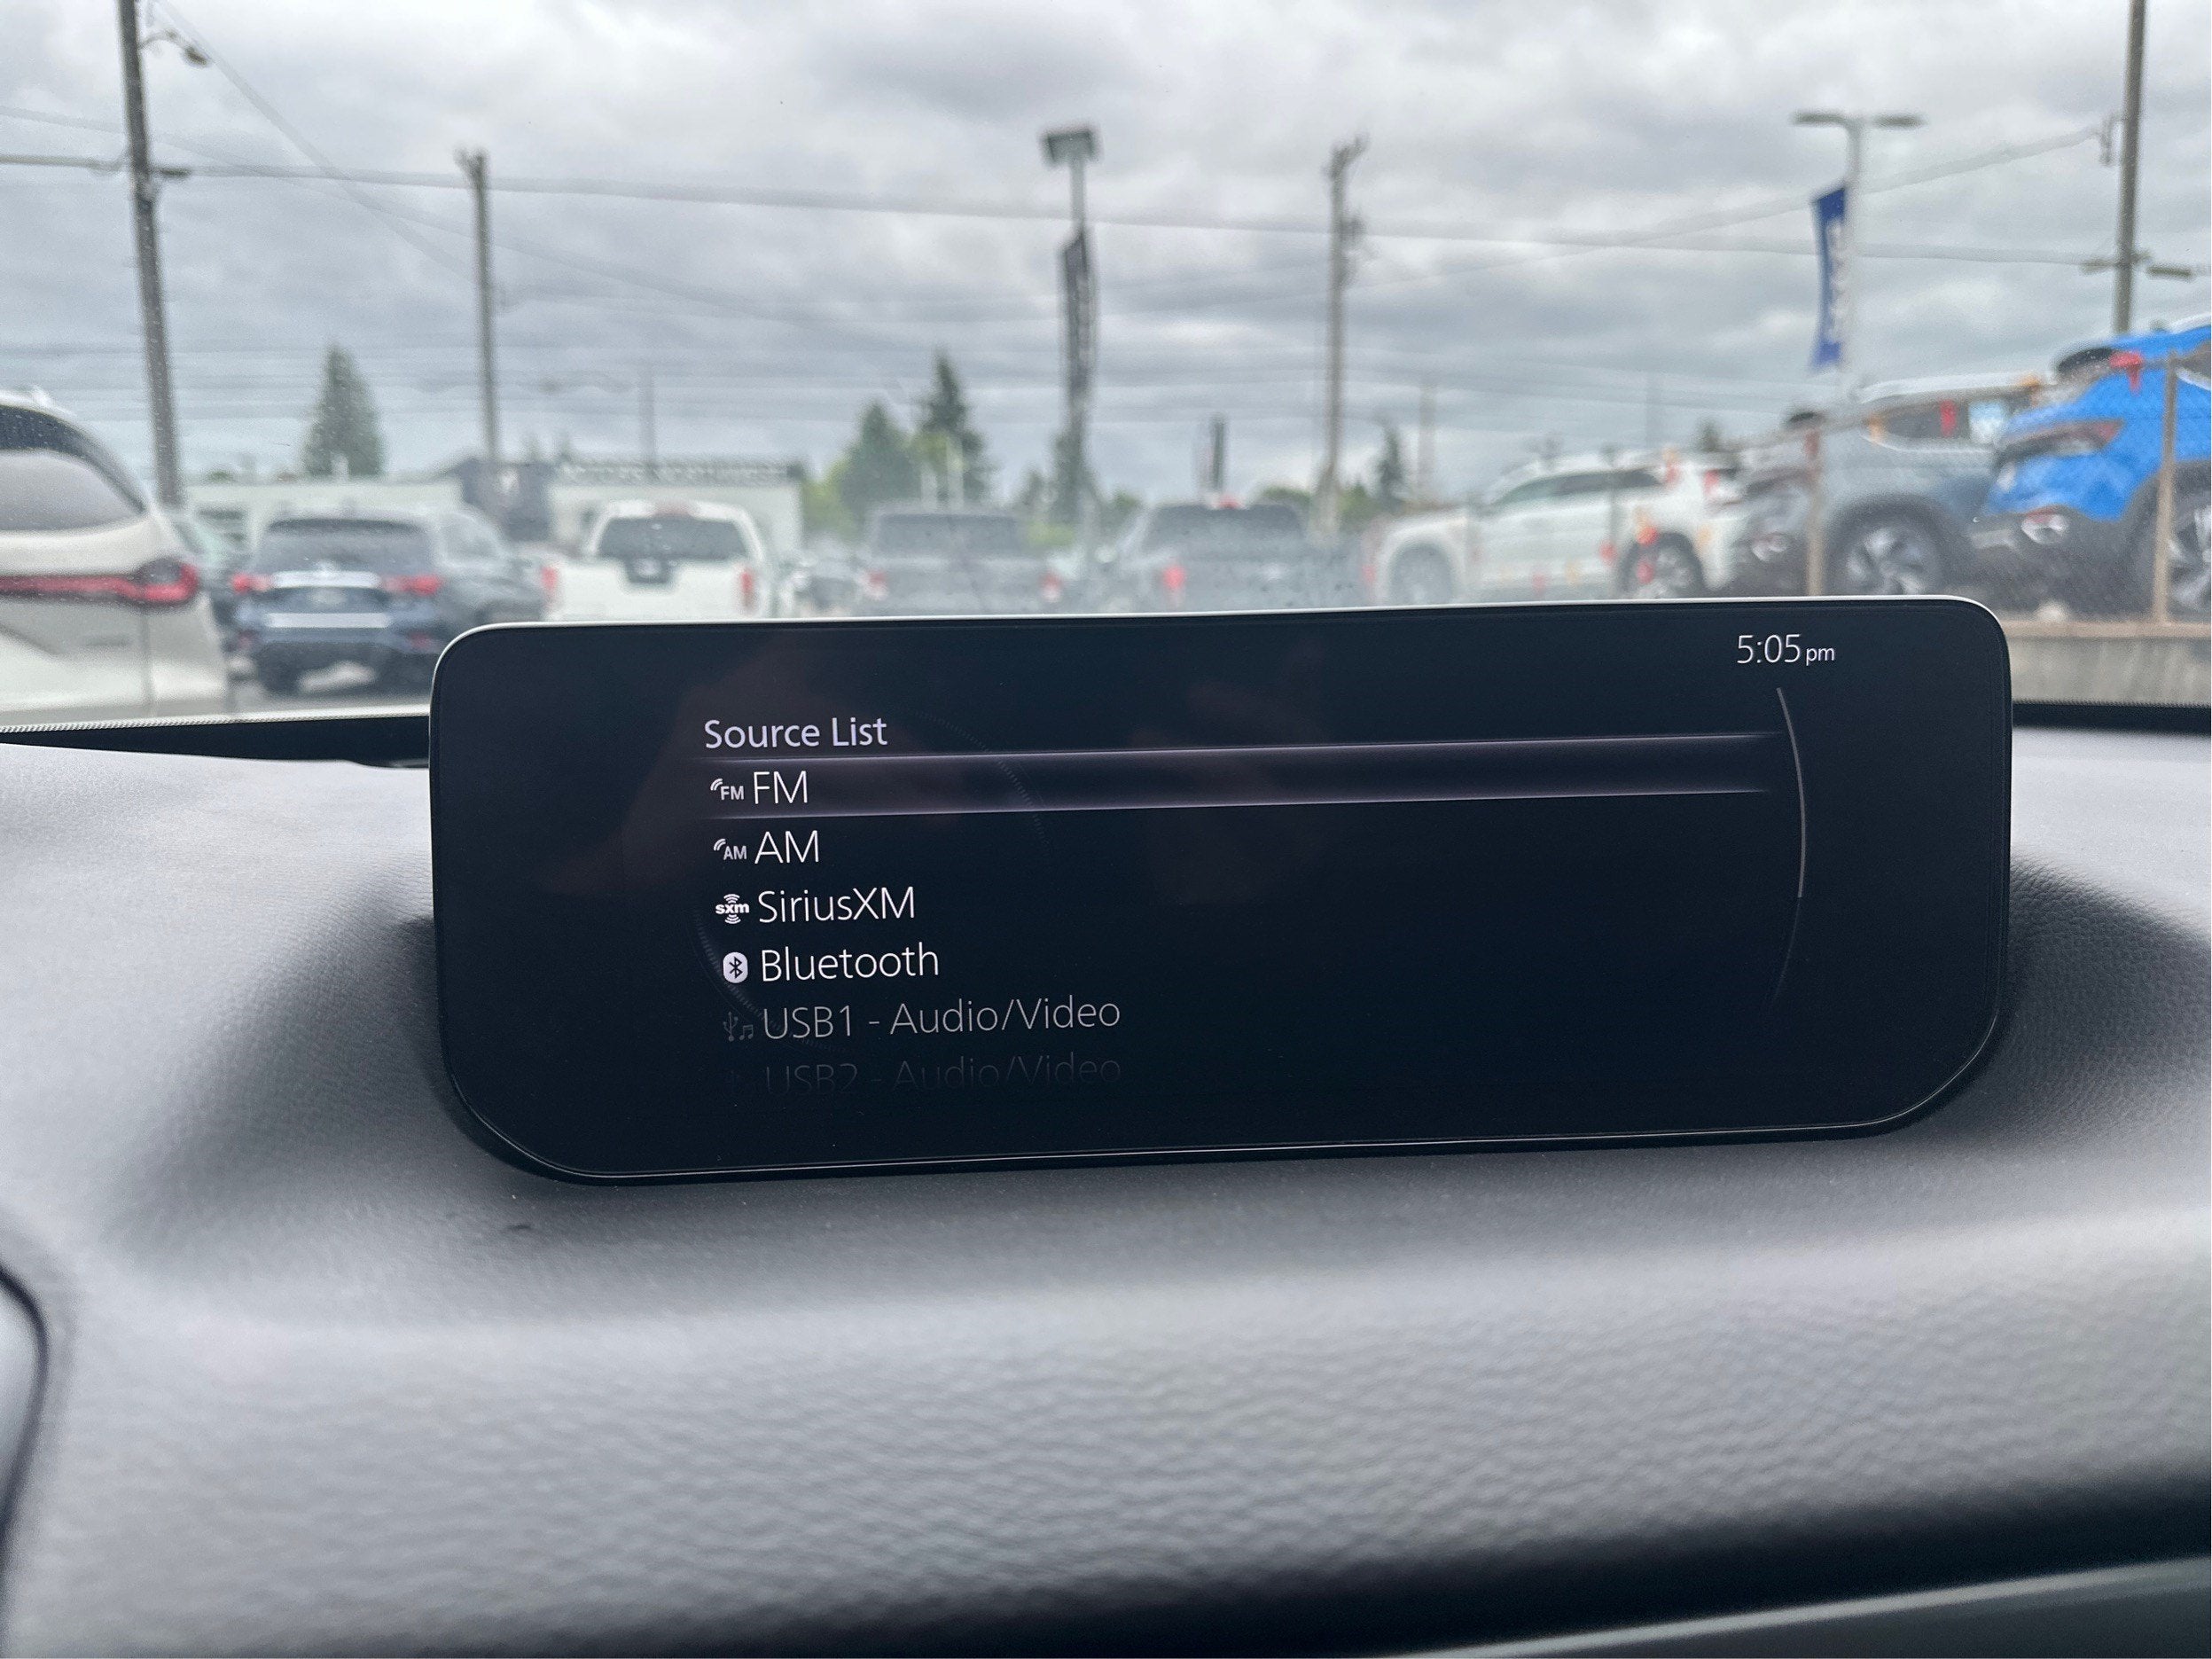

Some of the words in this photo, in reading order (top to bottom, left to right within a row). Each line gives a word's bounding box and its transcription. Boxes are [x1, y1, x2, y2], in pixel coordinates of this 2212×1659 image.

[704, 719, 821, 749] Source
[832, 716, 888, 747] List
[720, 785, 745, 801] FM
[753, 771, 809, 805] FM
[754, 830, 820, 865] AM
[758, 886, 915, 924] SiriusXM
[761, 941, 939, 982] Bluetooth
[762, 1005, 852, 1040] USB1
[889, 995, 1122, 1036] Audio/Video
